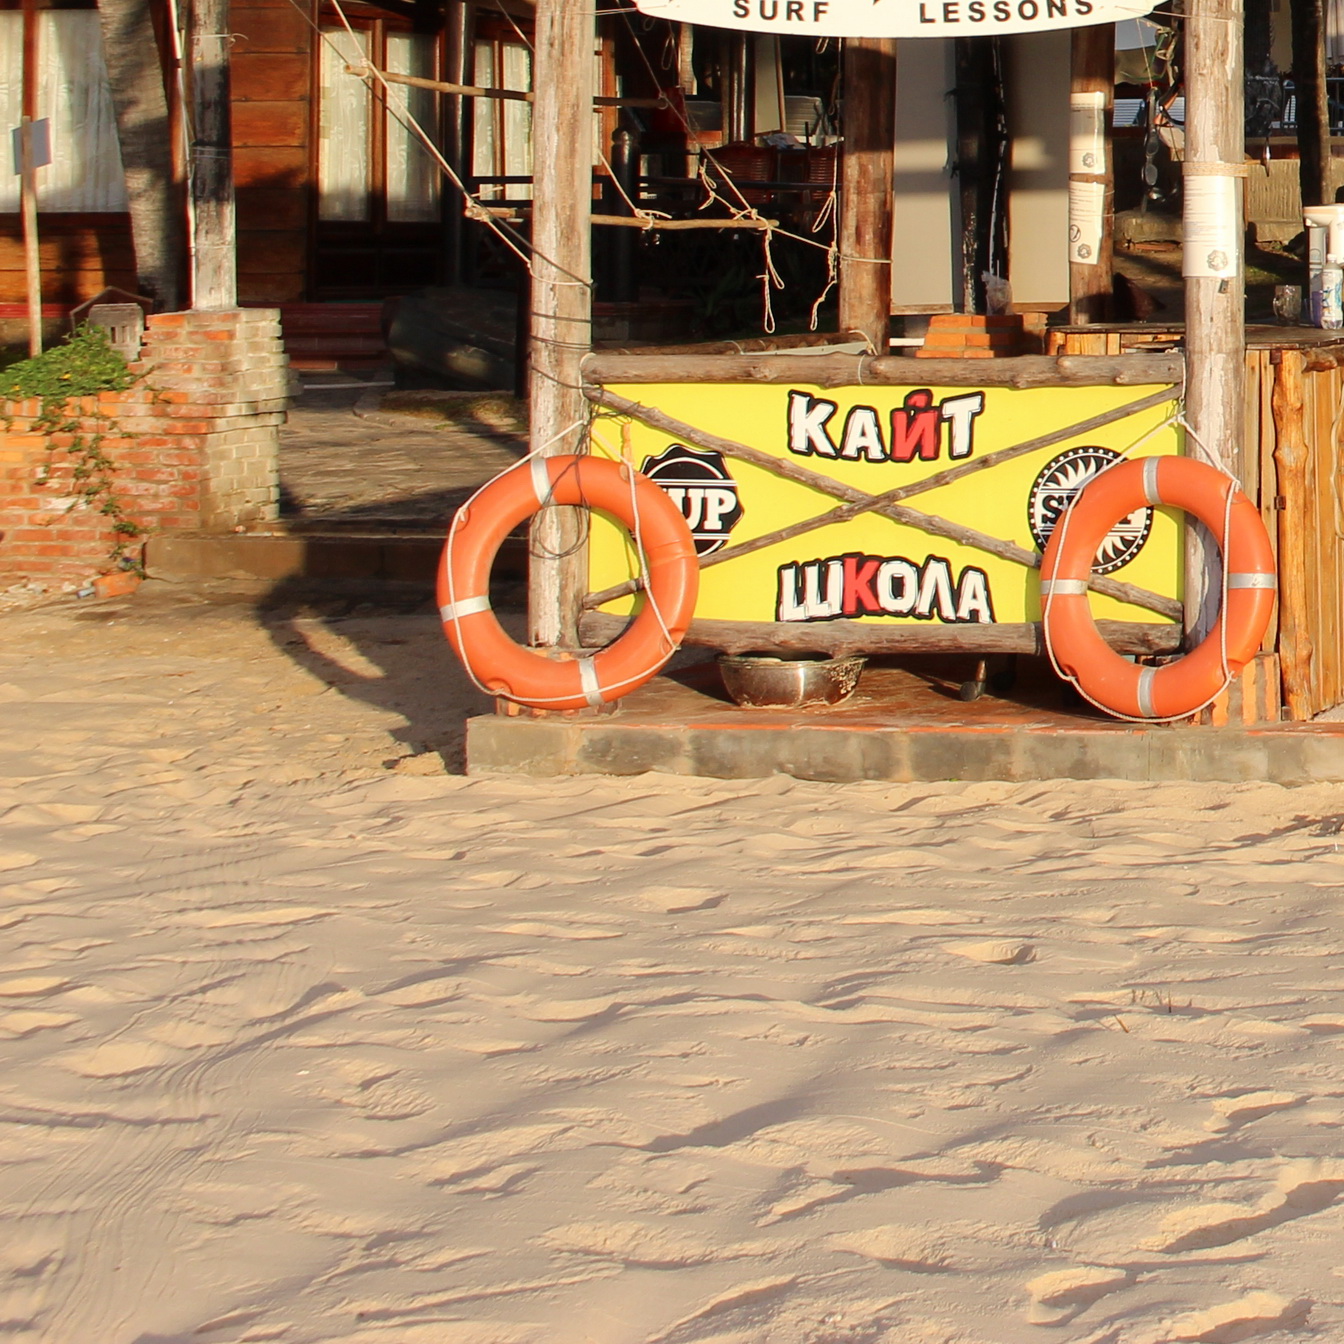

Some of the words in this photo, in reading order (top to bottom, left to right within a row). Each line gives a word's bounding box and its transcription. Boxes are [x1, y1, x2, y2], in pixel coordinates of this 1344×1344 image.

[788, 390, 984, 460] КАЙТ
[663, 488, 736, 530] UP
[778, 554, 992, 622] ШКОЛА
